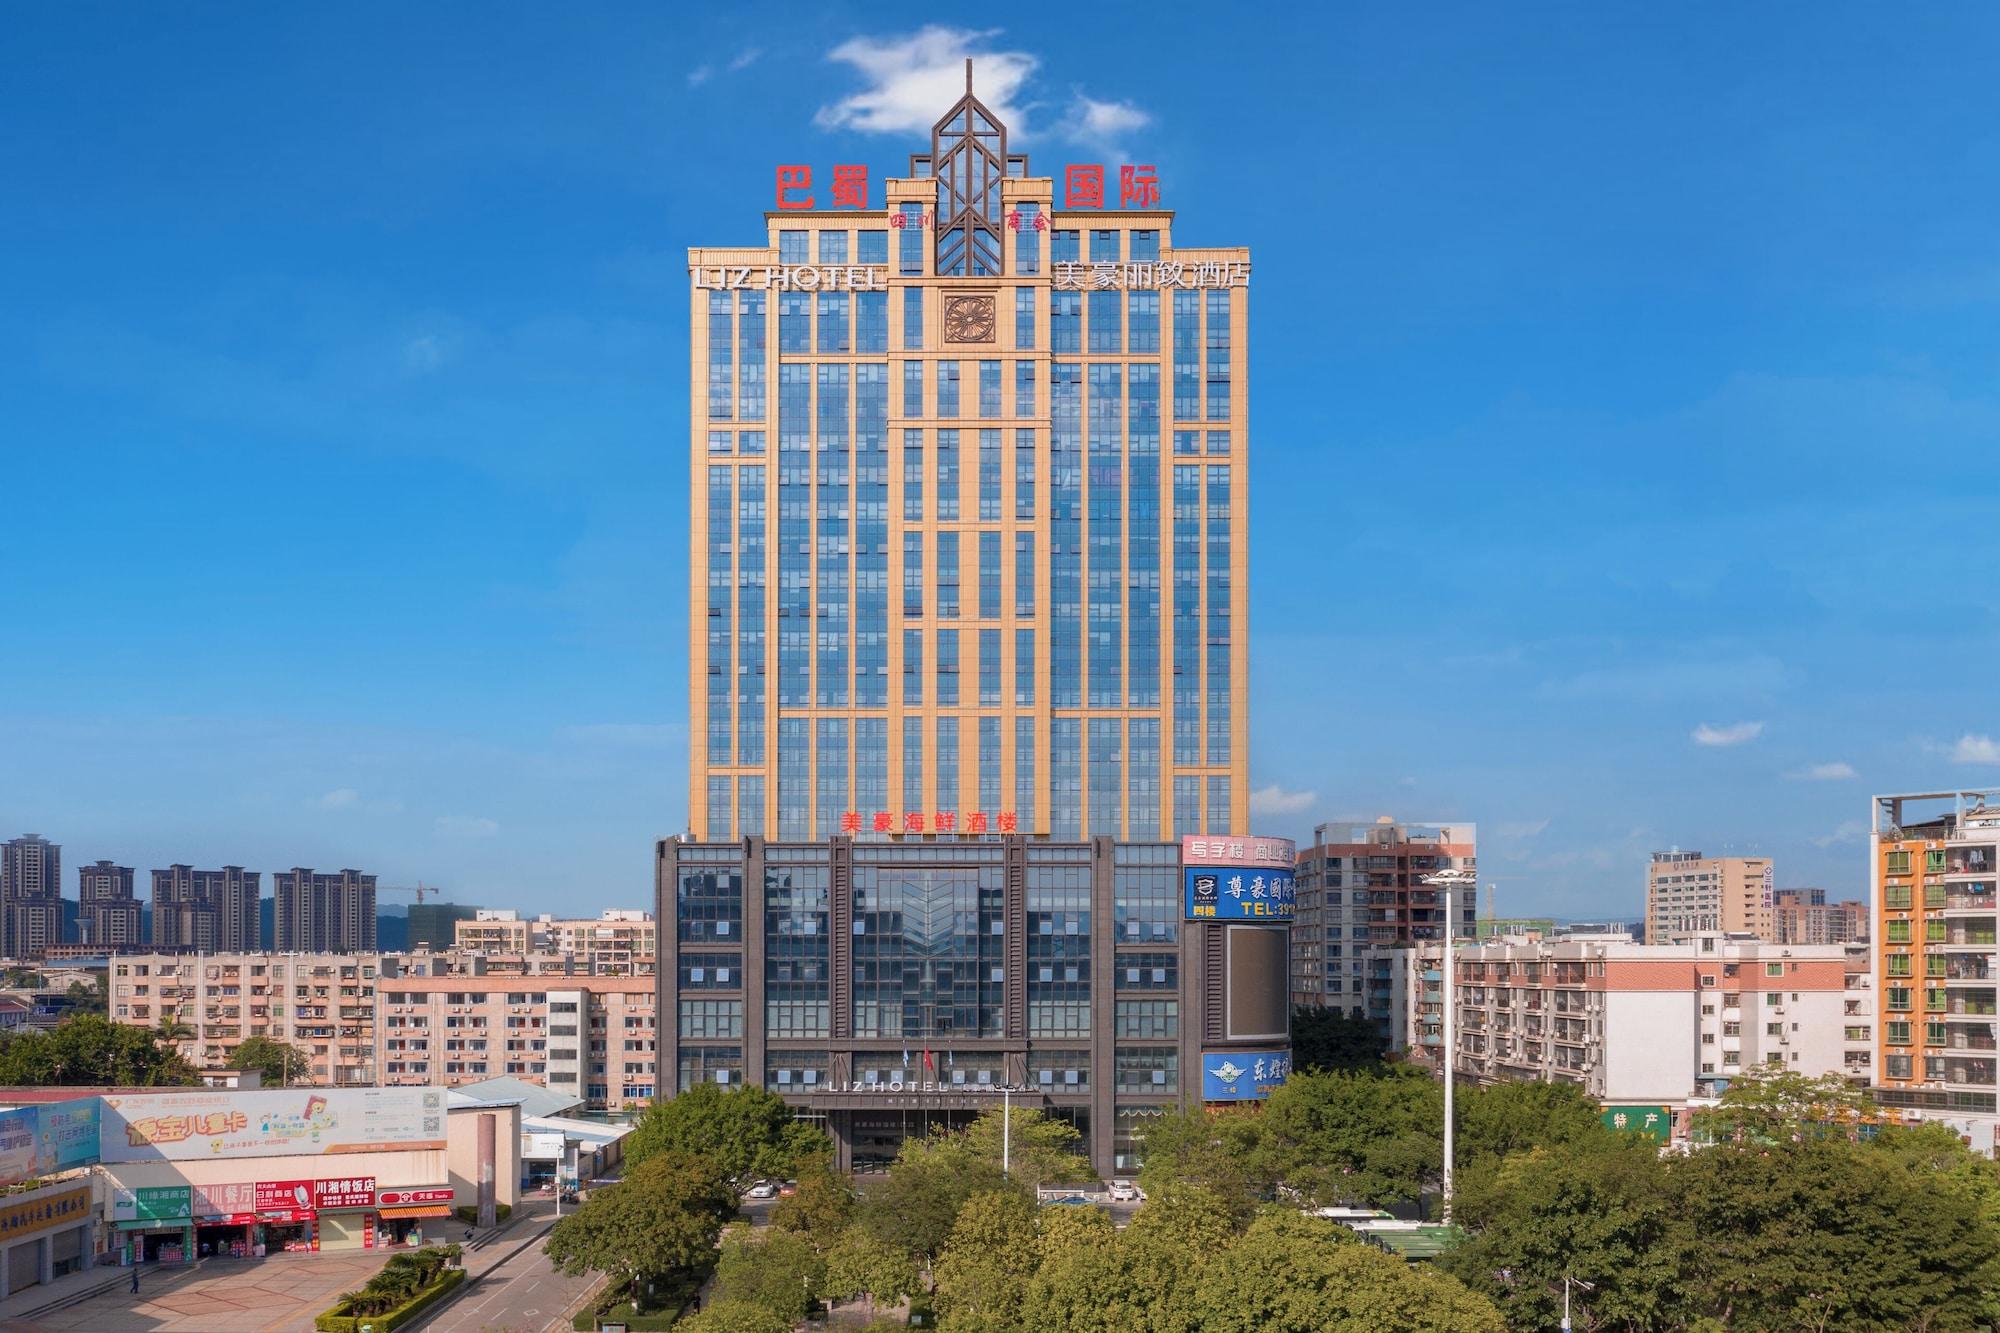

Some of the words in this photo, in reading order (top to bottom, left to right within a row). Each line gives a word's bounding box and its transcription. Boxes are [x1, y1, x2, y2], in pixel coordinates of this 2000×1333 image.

[776, 165, 868, 210] 巴蜀
[1065, 164, 1161, 209] 国际
[890, 210, 935, 231] 四川
[695, 266, 752, 290] LIZ
[765, 264, 888, 291] HOTEL
[1053, 260, 1251, 288] 美豪丽致酒店
[841, 812, 1017, 832] 美豪海鲜酒楼
[1192, 841, 1244, 859] 写字楼
[1224, 876, 1296, 900] 尊豪國際
[828, 1081, 863, 1092] LIZ
[872, 1081, 948, 1092] HOTEL
[1614, 1113, 1658, 1129] 特产
[194, 1186, 253, 1205] 湘川餐厅
